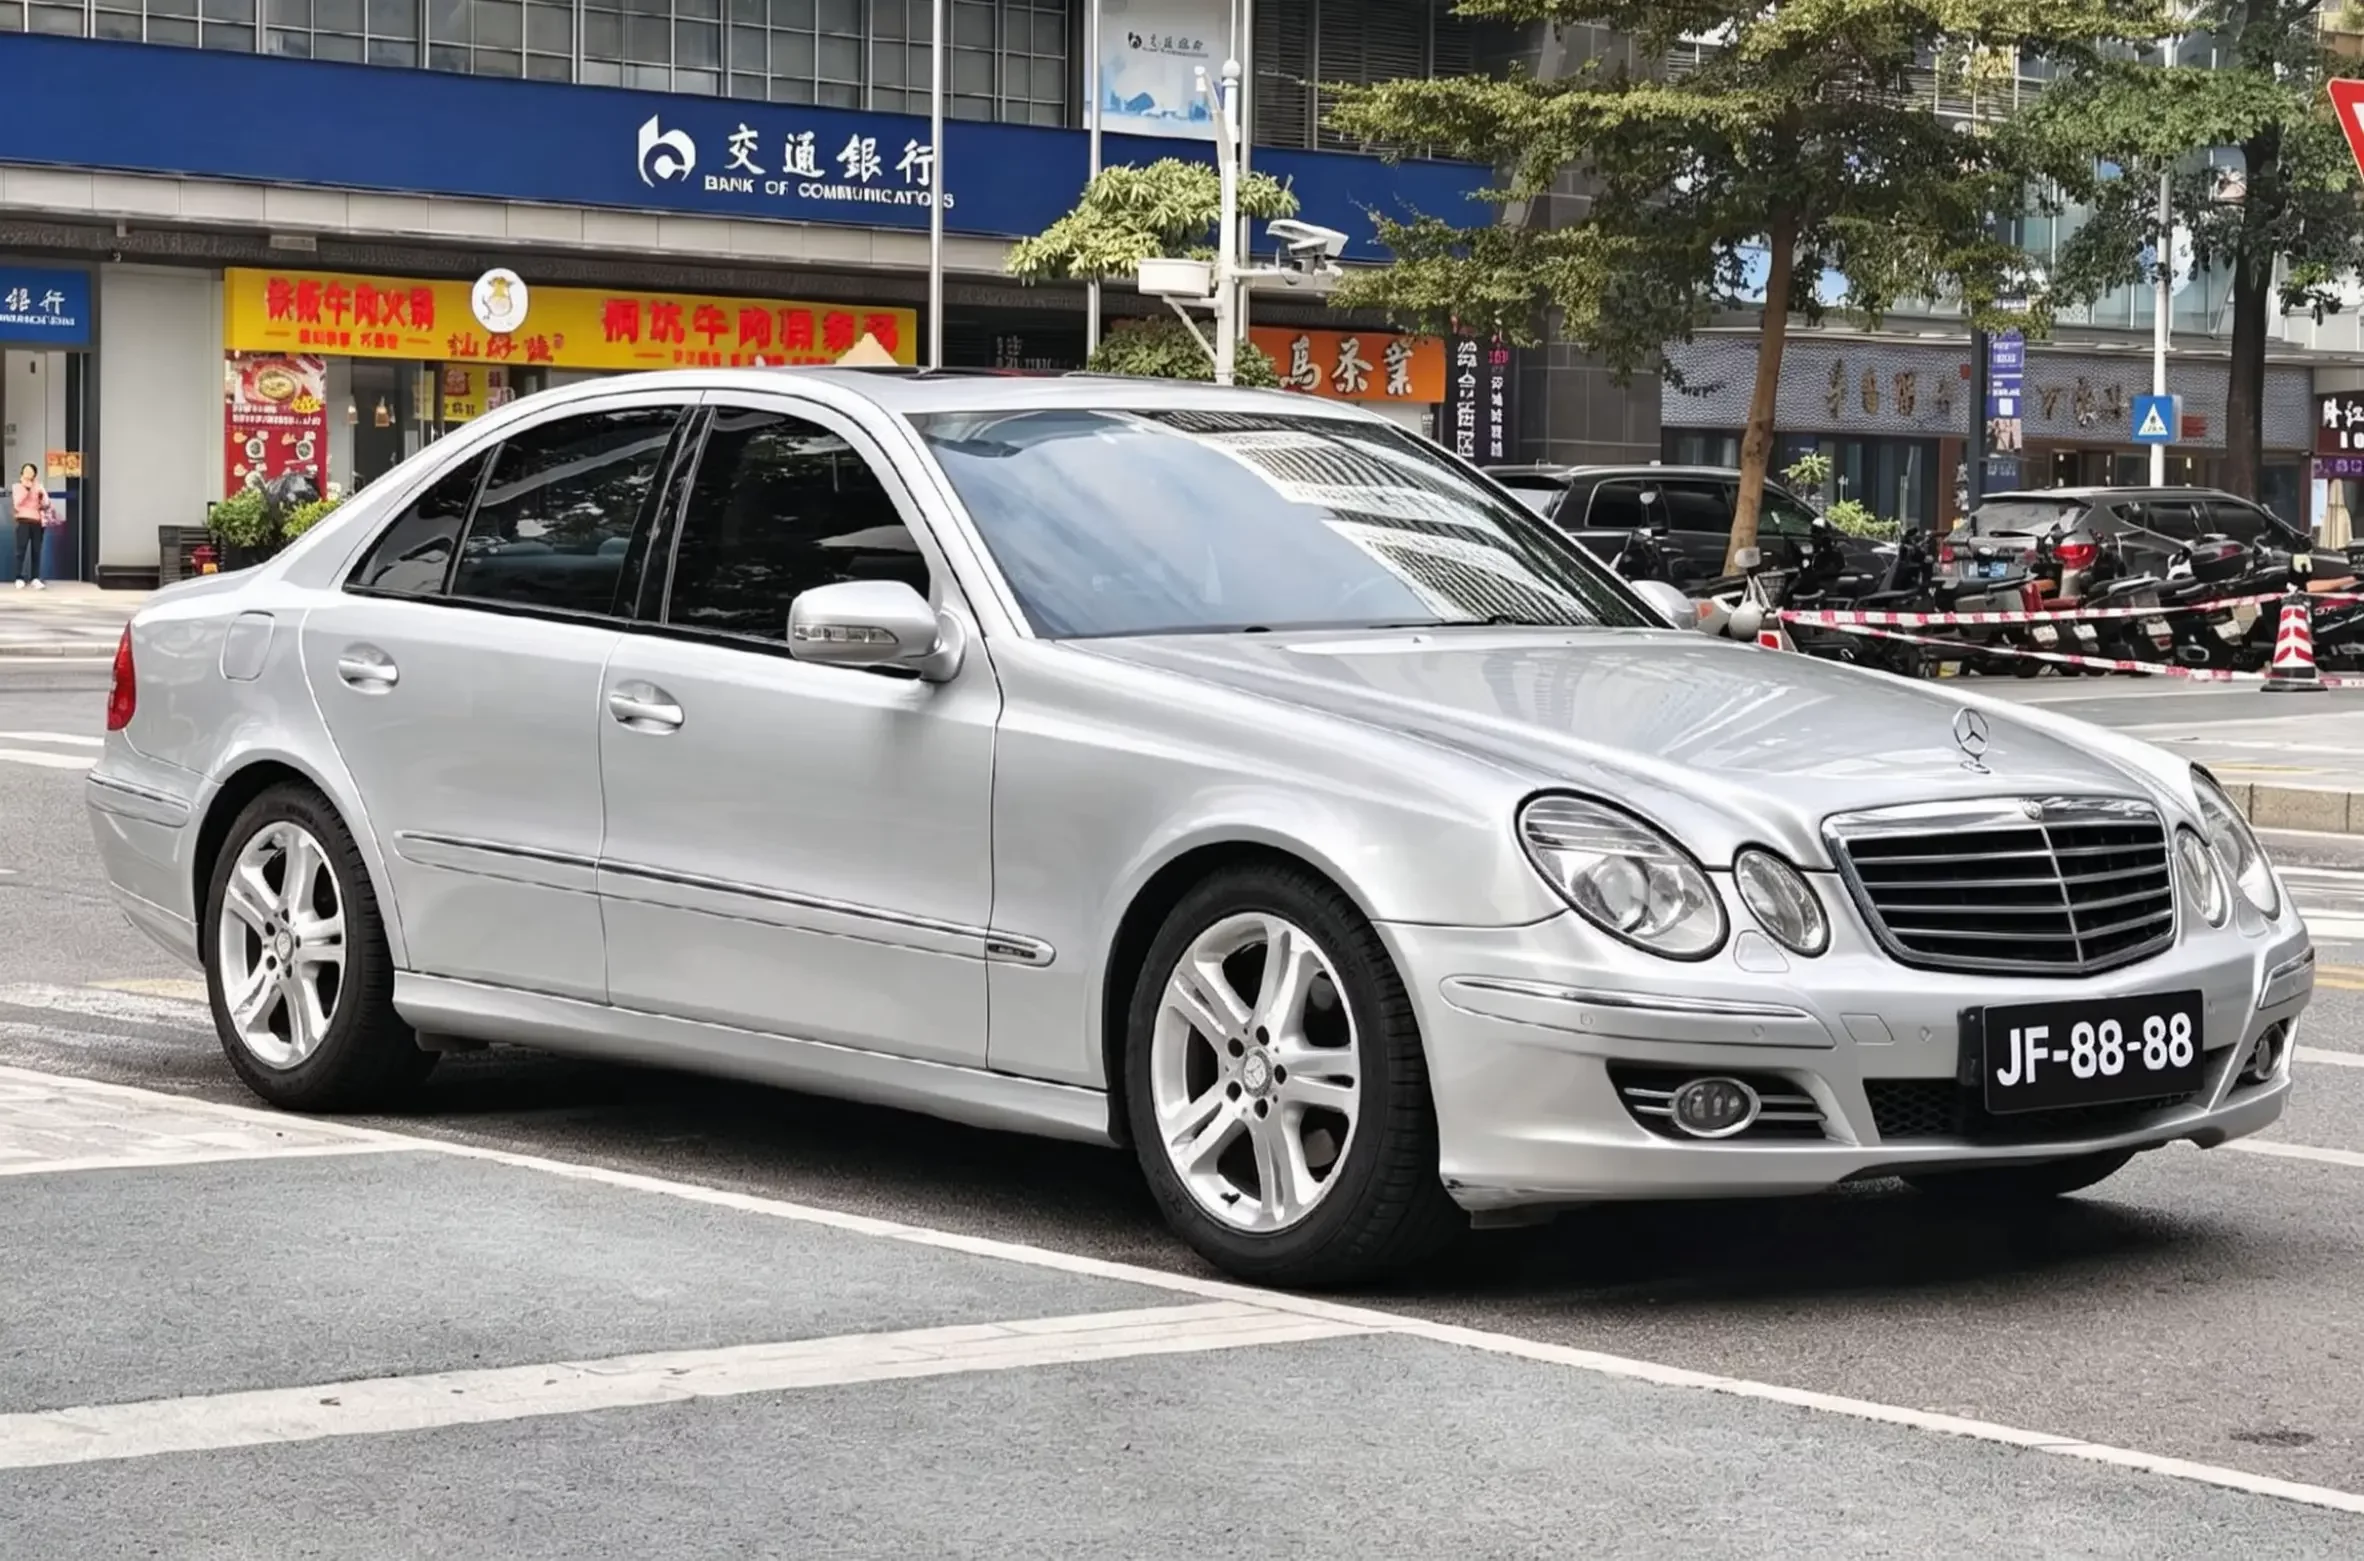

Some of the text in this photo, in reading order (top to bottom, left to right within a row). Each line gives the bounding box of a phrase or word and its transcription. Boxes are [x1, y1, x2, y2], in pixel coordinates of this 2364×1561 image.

[724, 122, 935, 187] 交通銀行
[704, 174, 956, 209] BANK OF COMMUNICATIOS
[1996, 1012, 2194, 1087] JF-88-88
